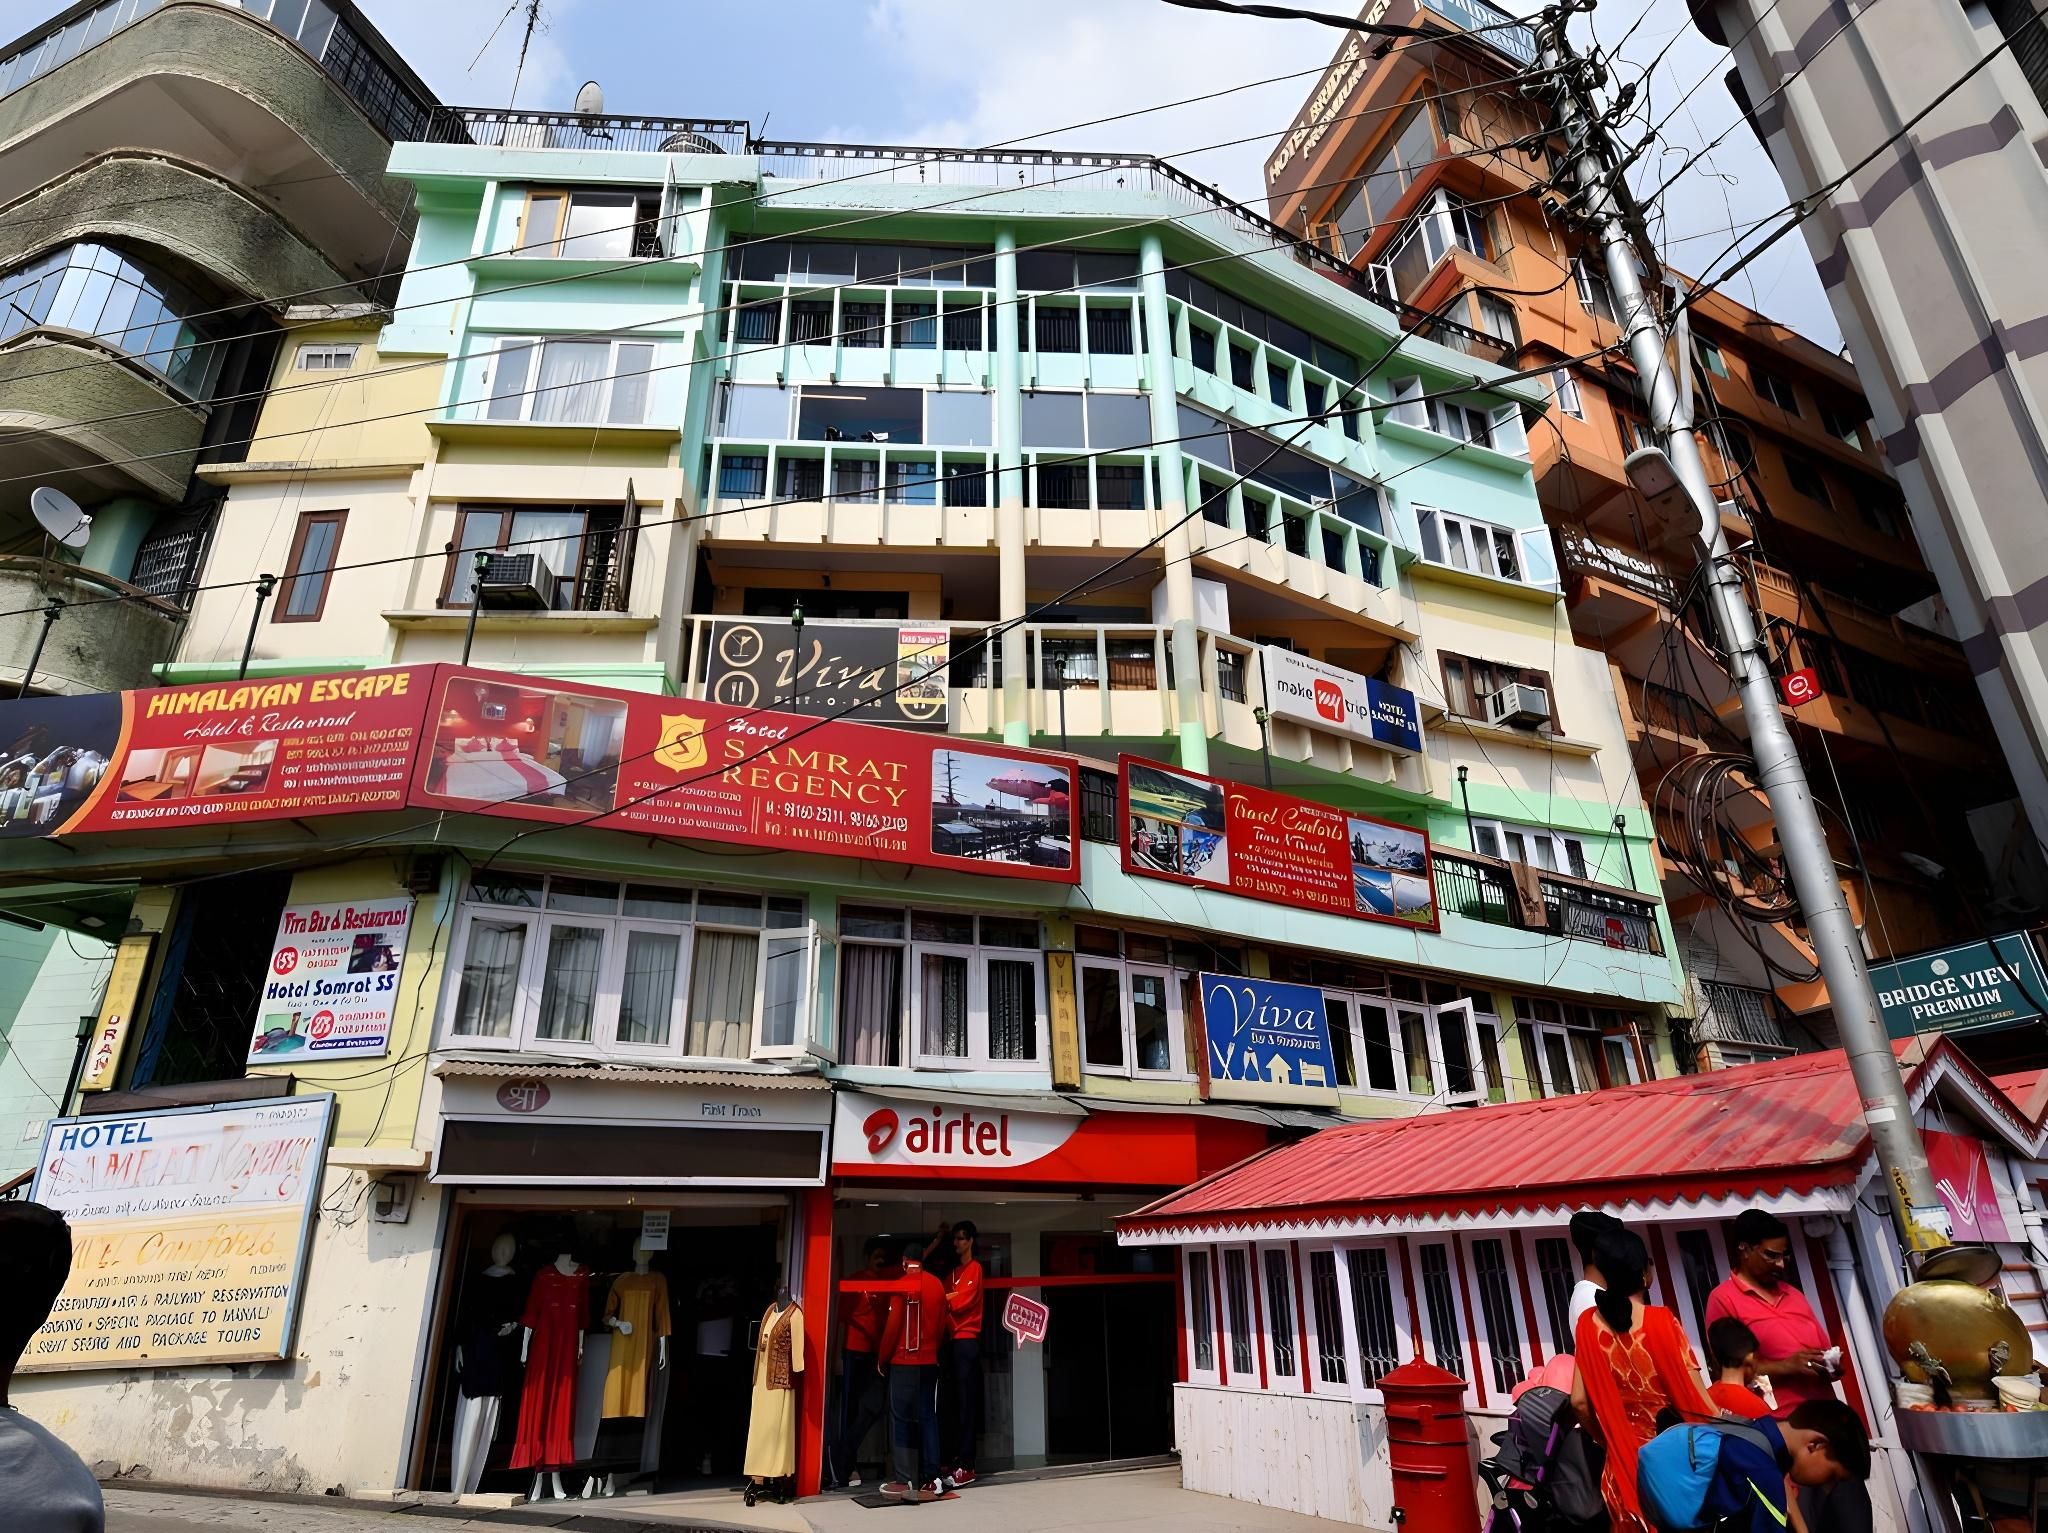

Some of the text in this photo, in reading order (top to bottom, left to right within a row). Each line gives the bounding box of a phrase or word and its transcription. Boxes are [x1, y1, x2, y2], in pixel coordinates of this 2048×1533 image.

[1269, 120, 1309, 185] HOTEL
[775, 639, 886, 692] Viva
[147, 672, 411, 719] HIMALAYAN ESCAPE
[1277, 680, 1368, 720] make my trip
[237, 717, 255, 736] &
[727, 717, 789, 740] Hotel
[724, 738, 908, 782] SAMRAT
[722, 764, 908, 807] REGENCY
[1230, 795, 1278, 825] Travel
[266, 979, 310, 1000] Hotel
[375, 973, 396, 992] SS
[1878, 961, 2021, 1009] BRIDGE VIEW
[1209, 984, 1316, 1038] Viva
[1911, 988, 2003, 1020] PREMIUM
[59, 1121, 153, 1151] HOTEL
[905, 1105, 1012, 1157] airtel
[154, 1291, 206, 1307] RAILWAY
[212, 1285, 289, 1303] RESERVATION
[201, 1310, 216, 1323] TO
[116, 1335, 141, 1350] AND
[151, 1331, 208, 1347] PACKAGE
[217, 1327, 261, 1344] TOURS
